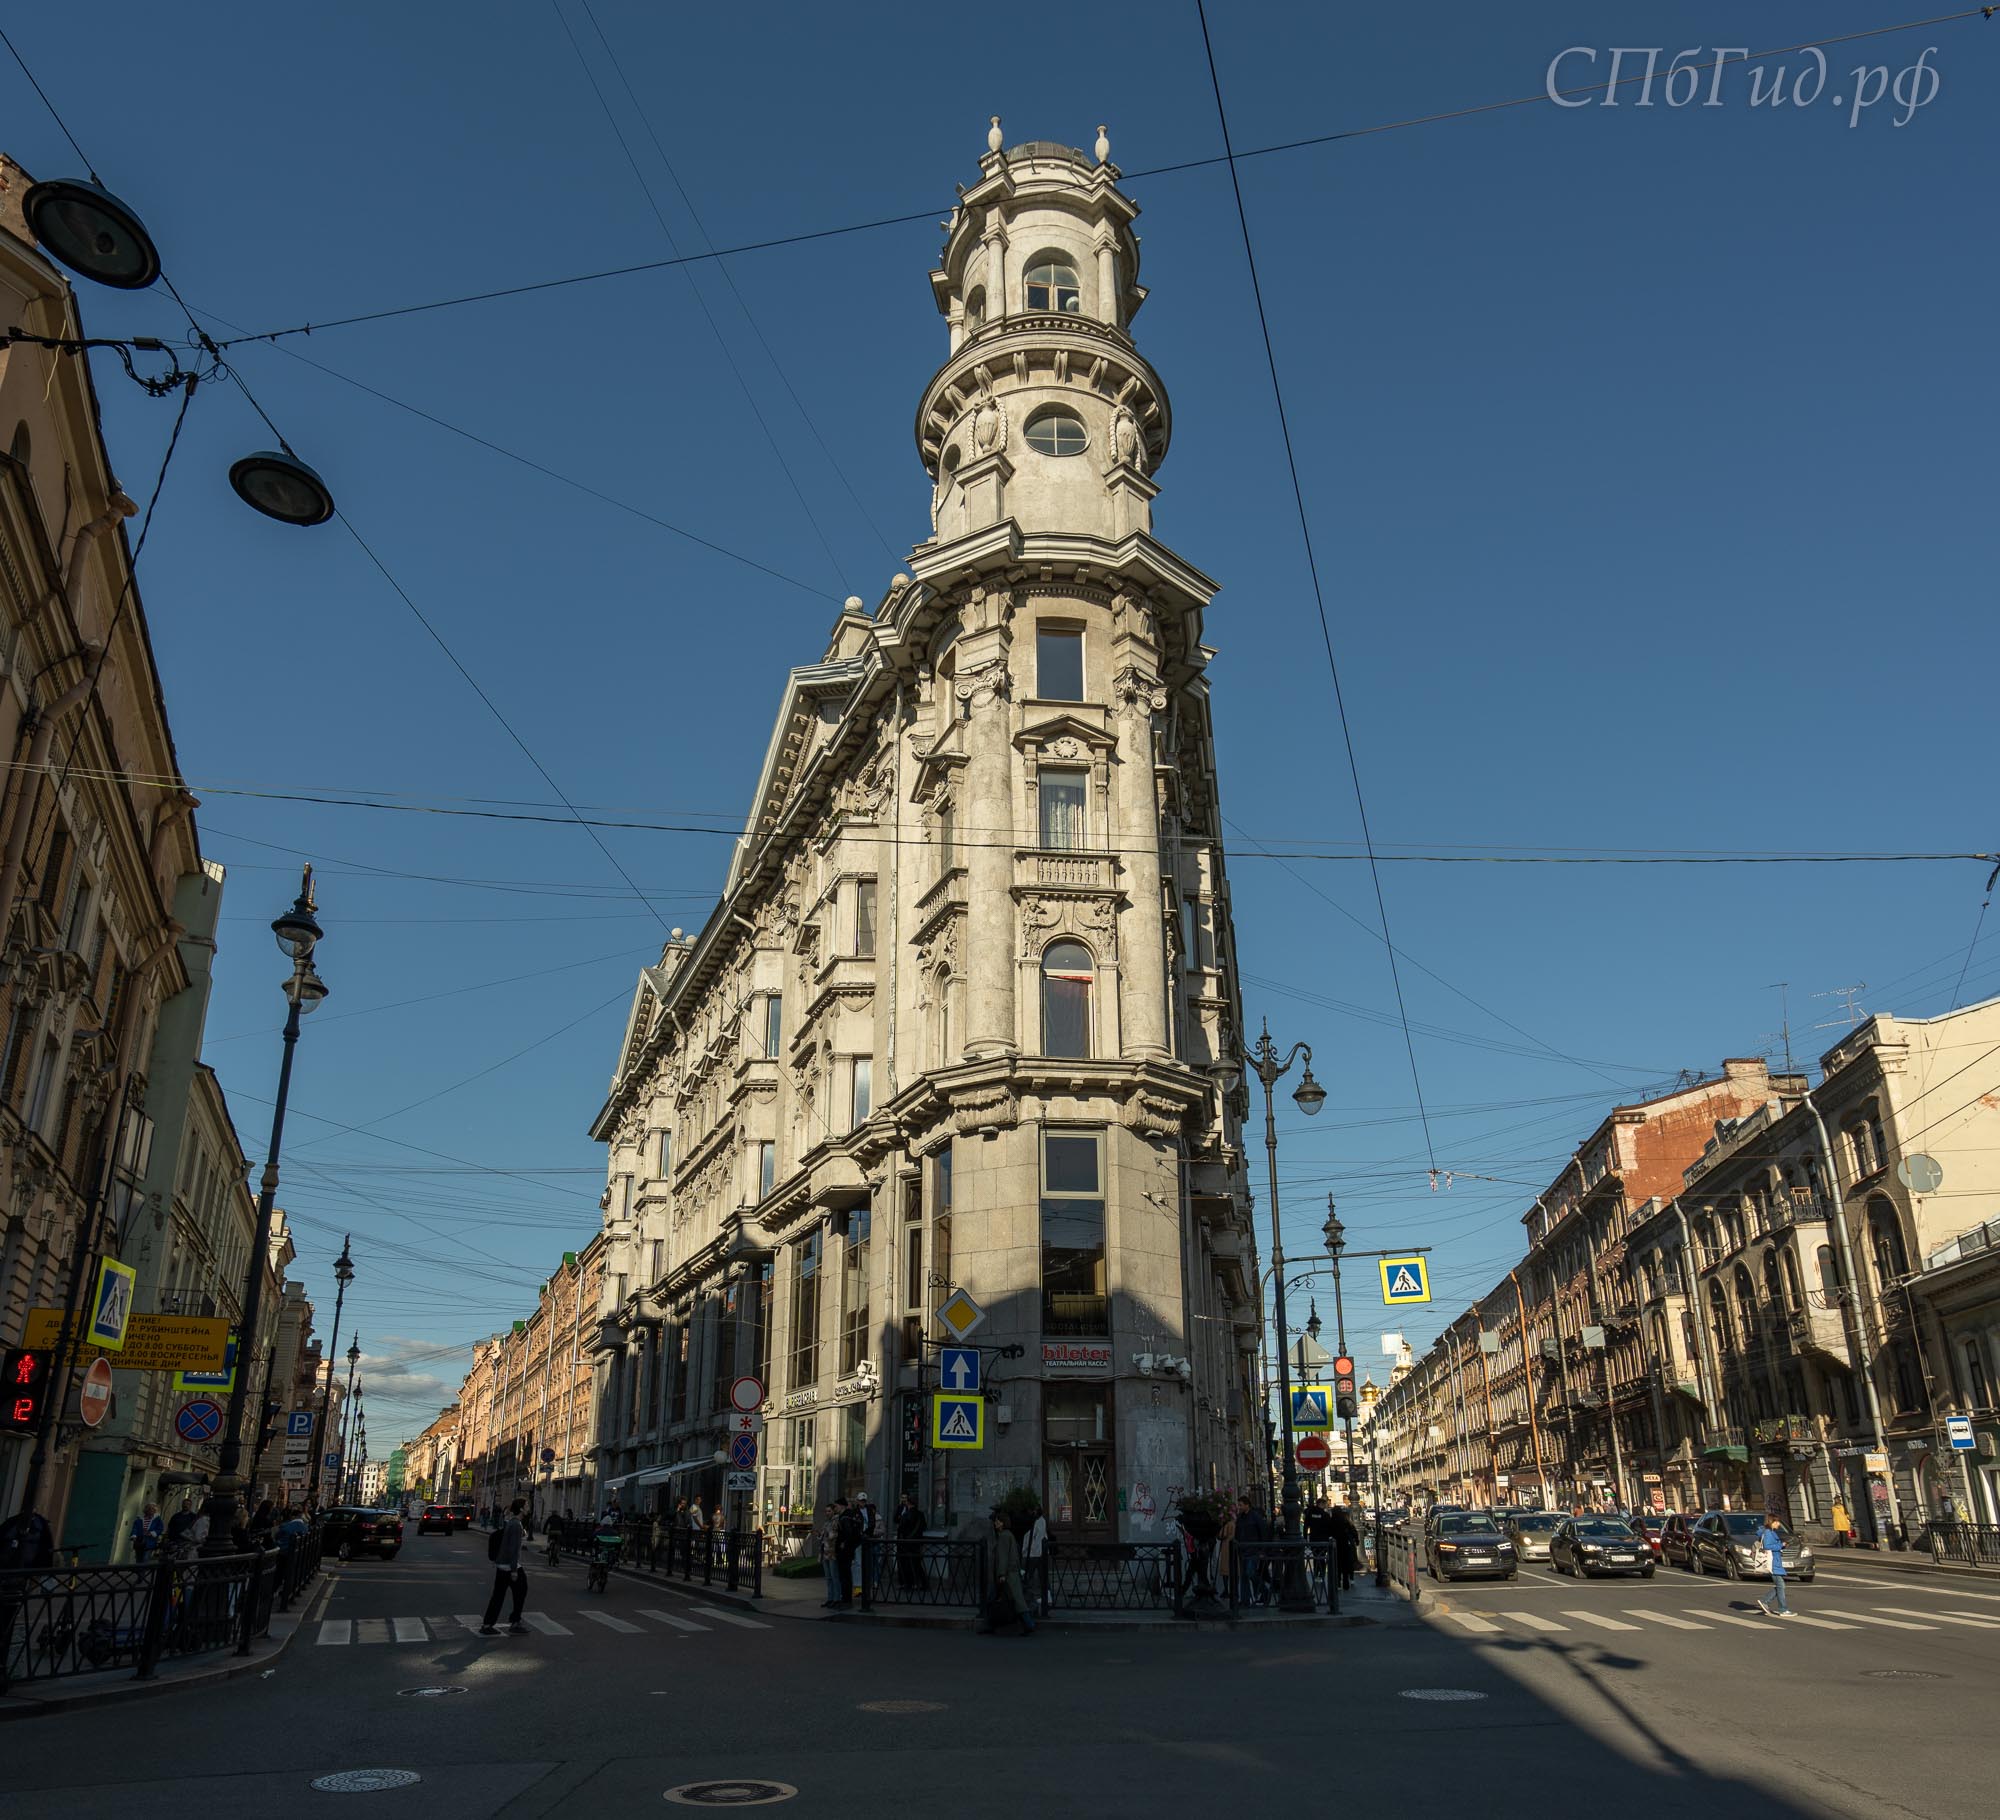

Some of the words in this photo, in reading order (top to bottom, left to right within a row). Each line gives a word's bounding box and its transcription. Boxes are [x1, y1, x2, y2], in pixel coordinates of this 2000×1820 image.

[140, 1325, 210, 1336] РУБИНШТЕЙНА
[128, 1341, 142, 1350] ДО
[165, 1343, 209, 1352] СУББОТЫ
[1042, 1344, 1111, 1360] bileter
[150, 1351, 219, 1361] ВОСКРЕСЕНЬЯ
[160, 1360, 181, 1369] ДНИ
[1045, 1360, 1087, 1368] ТЕАТРАЛЬНАЯ
[13, 1399, 32, 1421] 12
[294, 1414, 308, 1432] P
